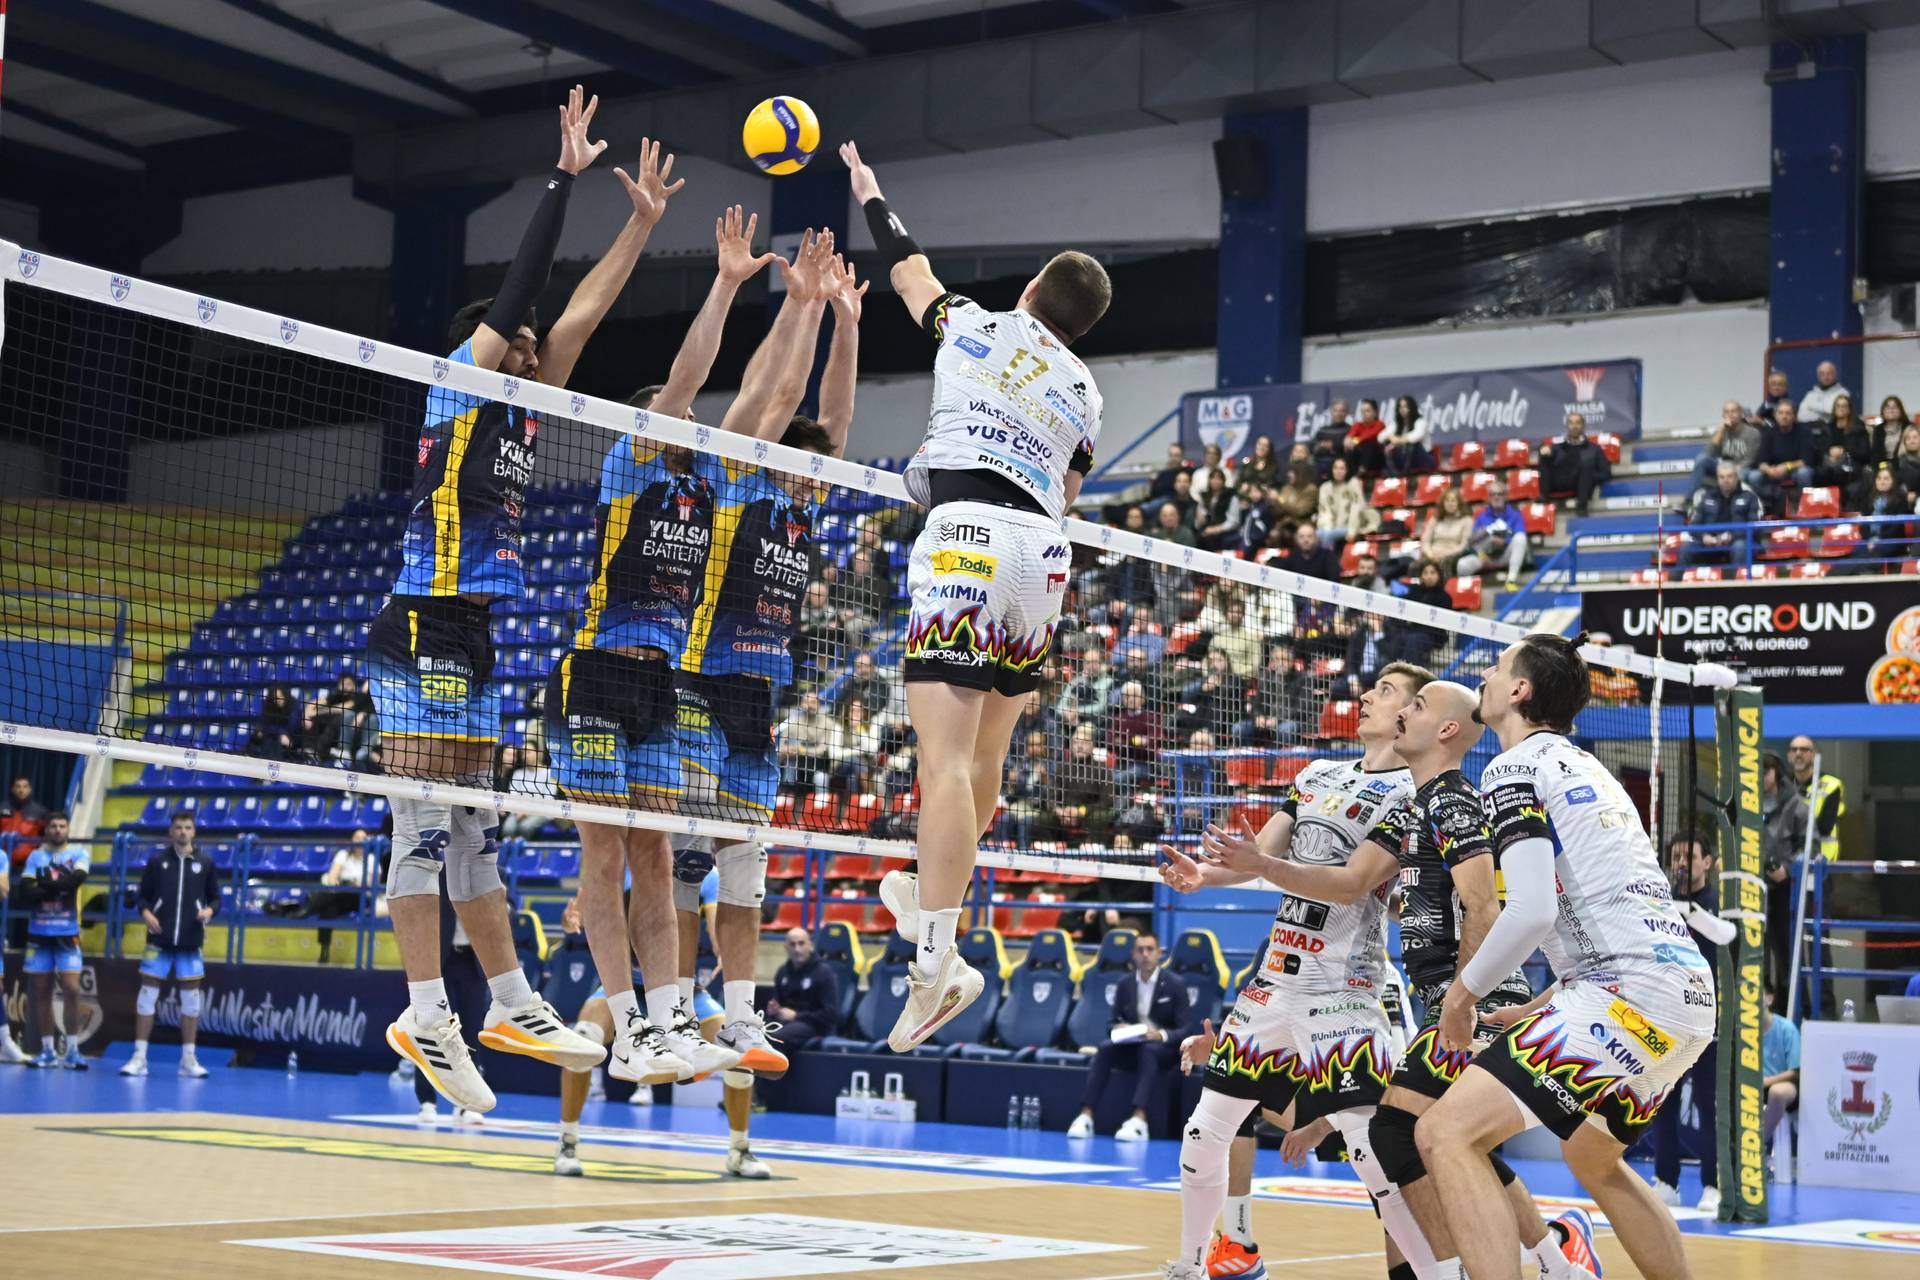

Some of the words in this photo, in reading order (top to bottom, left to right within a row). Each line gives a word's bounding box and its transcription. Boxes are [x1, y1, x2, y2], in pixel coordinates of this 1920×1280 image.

[1001, 348, 1050, 389] 17
[499, 437, 535, 470] YUAS
[650, 520, 709, 546] YUASA
[642, 540, 705, 564] BATTERY
[958, 556, 993, 576] Todis
[1623, 601, 1875, 636] UNDERGROUND
[1756, 637, 1809, 651] GIORGIO
[1796, 667, 1817, 677] TAKE
[1738, 707, 1761, 814] BANCA
[1484, 765, 1538, 782] PAVICEM
[1495, 787, 1516, 798] Centro
[1496, 792, 1534, 805] Siderurgico
[1386, 810, 1410, 828] CS
[1400, 915, 1431, 928] STEMS
[1644, 919, 1670, 937] VUS
[1274, 928, 1325, 954] CONAD
[1402, 938, 1433, 951] TOR
[1740, 964, 1761, 1072] BANCA
[1643, 1026, 1669, 1056] Todis
[1740, 1084, 1763, 1206] CREDEM
[1837, 1142, 1867, 1152] COMUNE
[1824, 1150, 1890, 1163] GROTTAZZOLINA
